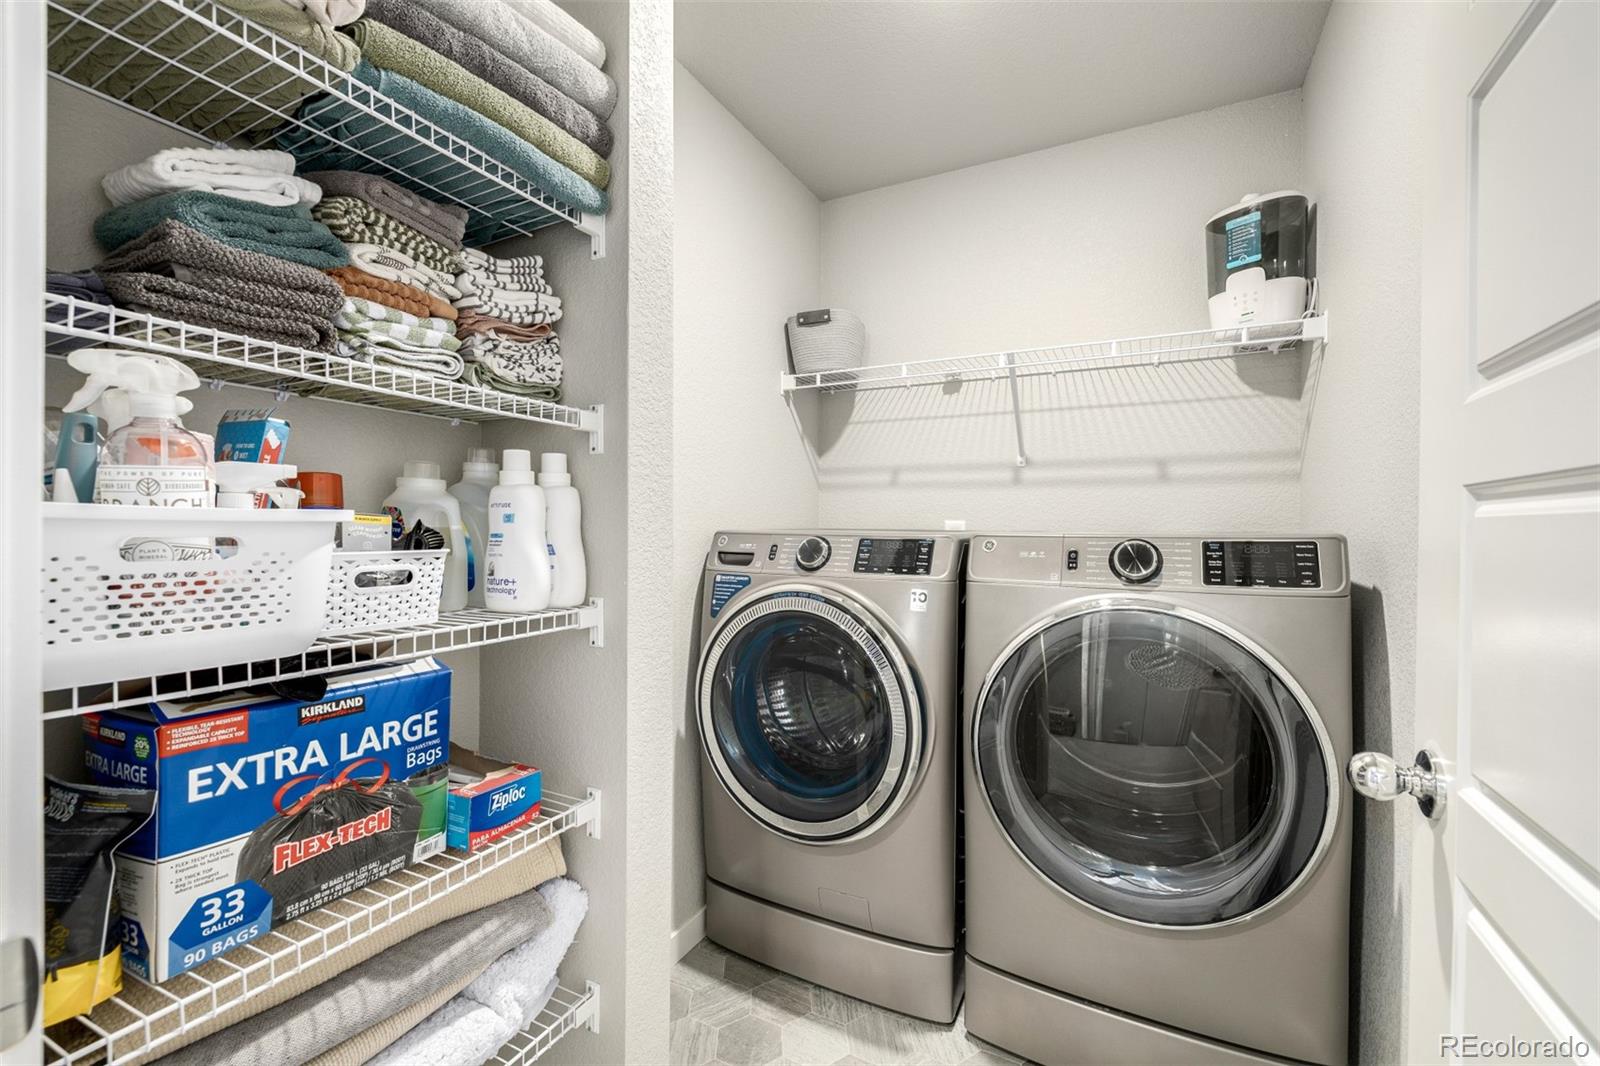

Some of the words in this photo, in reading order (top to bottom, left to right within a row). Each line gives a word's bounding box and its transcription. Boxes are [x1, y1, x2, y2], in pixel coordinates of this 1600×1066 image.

[301, 696, 364, 718] KIRKLAND
[171, 732, 210, 745] EXPANDABLE
[210, 726, 238, 736] CAPACITY
[406, 738, 441, 753] DRAWSTRING
[85, 751, 110, 778] EXTRA
[111, 760, 148, 784] LARGE
[187, 739, 329, 803] EXTRA
[339, 709, 439, 762] LARGE
[406, 746, 442, 769] Bags
[491, 786, 526, 811] Ziploc
[272, 806, 391, 876] FLEX-TECH
[472, 833, 490, 845] PARA
[491, 814, 526, 836] ALMACENAR
[200, 888, 245, 929] 33
[201, 914, 244, 937] GALLON
[183, 948, 206, 968] 90
[211, 924, 258, 956] BAGS
